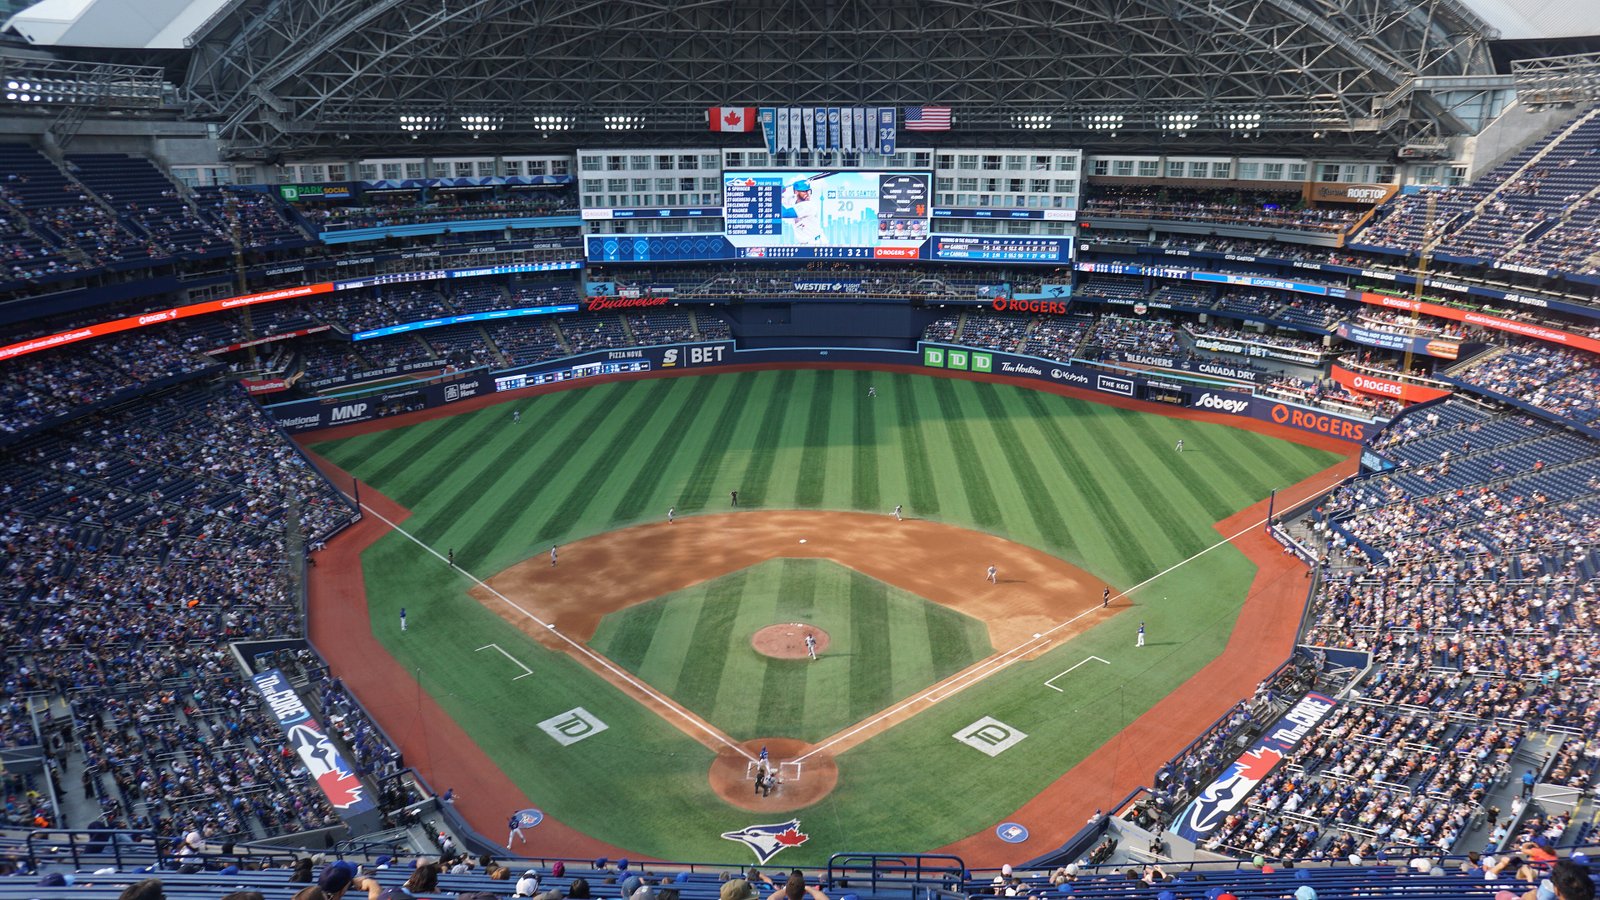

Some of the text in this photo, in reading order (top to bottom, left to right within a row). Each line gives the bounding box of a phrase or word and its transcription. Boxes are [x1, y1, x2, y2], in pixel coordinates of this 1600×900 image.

[880, 128, 895, 140] 32
[283, 189, 297, 198] TD
[1347, 189, 1387, 199] ROOFTOP
[838, 201, 854, 211] 20
[1442, 282, 1469, 292] HALLADAY
[585, 296, 669, 311] Budweiser
[1010, 298, 1066, 314] ROGERS
[1389, 300, 1410, 308] ROGERS
[1519, 297, 1548, 307] BAUTISTA
[146, 313, 167, 323] ROGERS
[691, 346, 725, 363] BET
[1195, 339, 1242, 353] theScore
[1250, 347, 1268, 357] BET
[927, 351, 942, 363] TD
[951, 354, 966, 366] TD
[974, 356, 989, 368] TD
[1127, 355, 1173, 368] BLEACHERS
[1002, 362, 1042, 375] Tim Hortons
[1199, 364, 1235, 377] CANADA
[311, 377, 331, 387] NEXEN
[1063, 372, 1088, 384] Kubota
[460, 381, 479, 390] Here's
[1363, 379, 1402, 395] ROGERS
[1195, 392, 1248, 413] Sobeys
[332, 403, 367, 421] MNP
[283, 414, 319, 428] National
[1292, 410, 1364, 440] ROGERS
[256, 675, 280, 689] TO
[266, 689, 307, 720] CORE
[1285, 697, 1333, 728] CORE
[553, 713, 593, 737] TD
[965, 724, 1011, 745] TD
[1272, 729, 1301, 744] TO
